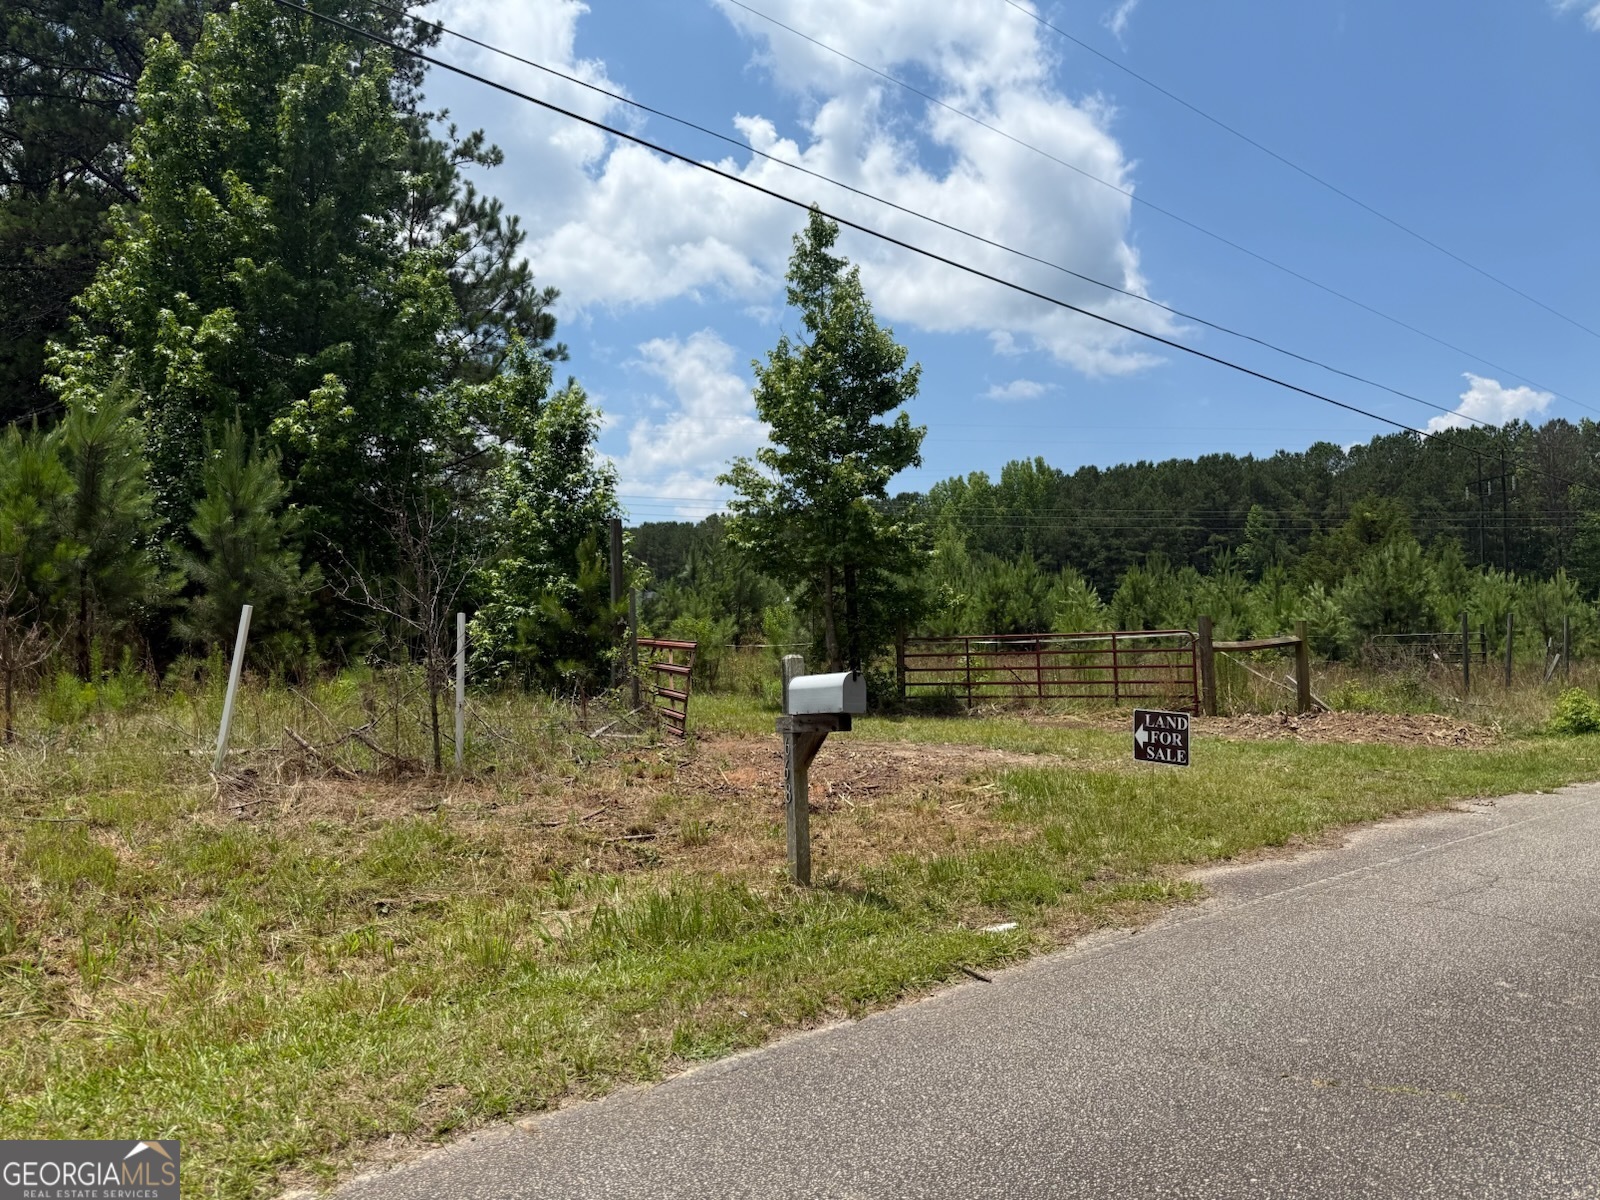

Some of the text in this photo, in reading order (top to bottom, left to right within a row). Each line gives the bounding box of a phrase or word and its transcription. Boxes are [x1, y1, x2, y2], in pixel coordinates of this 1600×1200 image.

[1145, 714, 1188, 731] LAND
[1151, 730, 1183, 746] FOR
[1146, 745, 1187, 763] SALE
